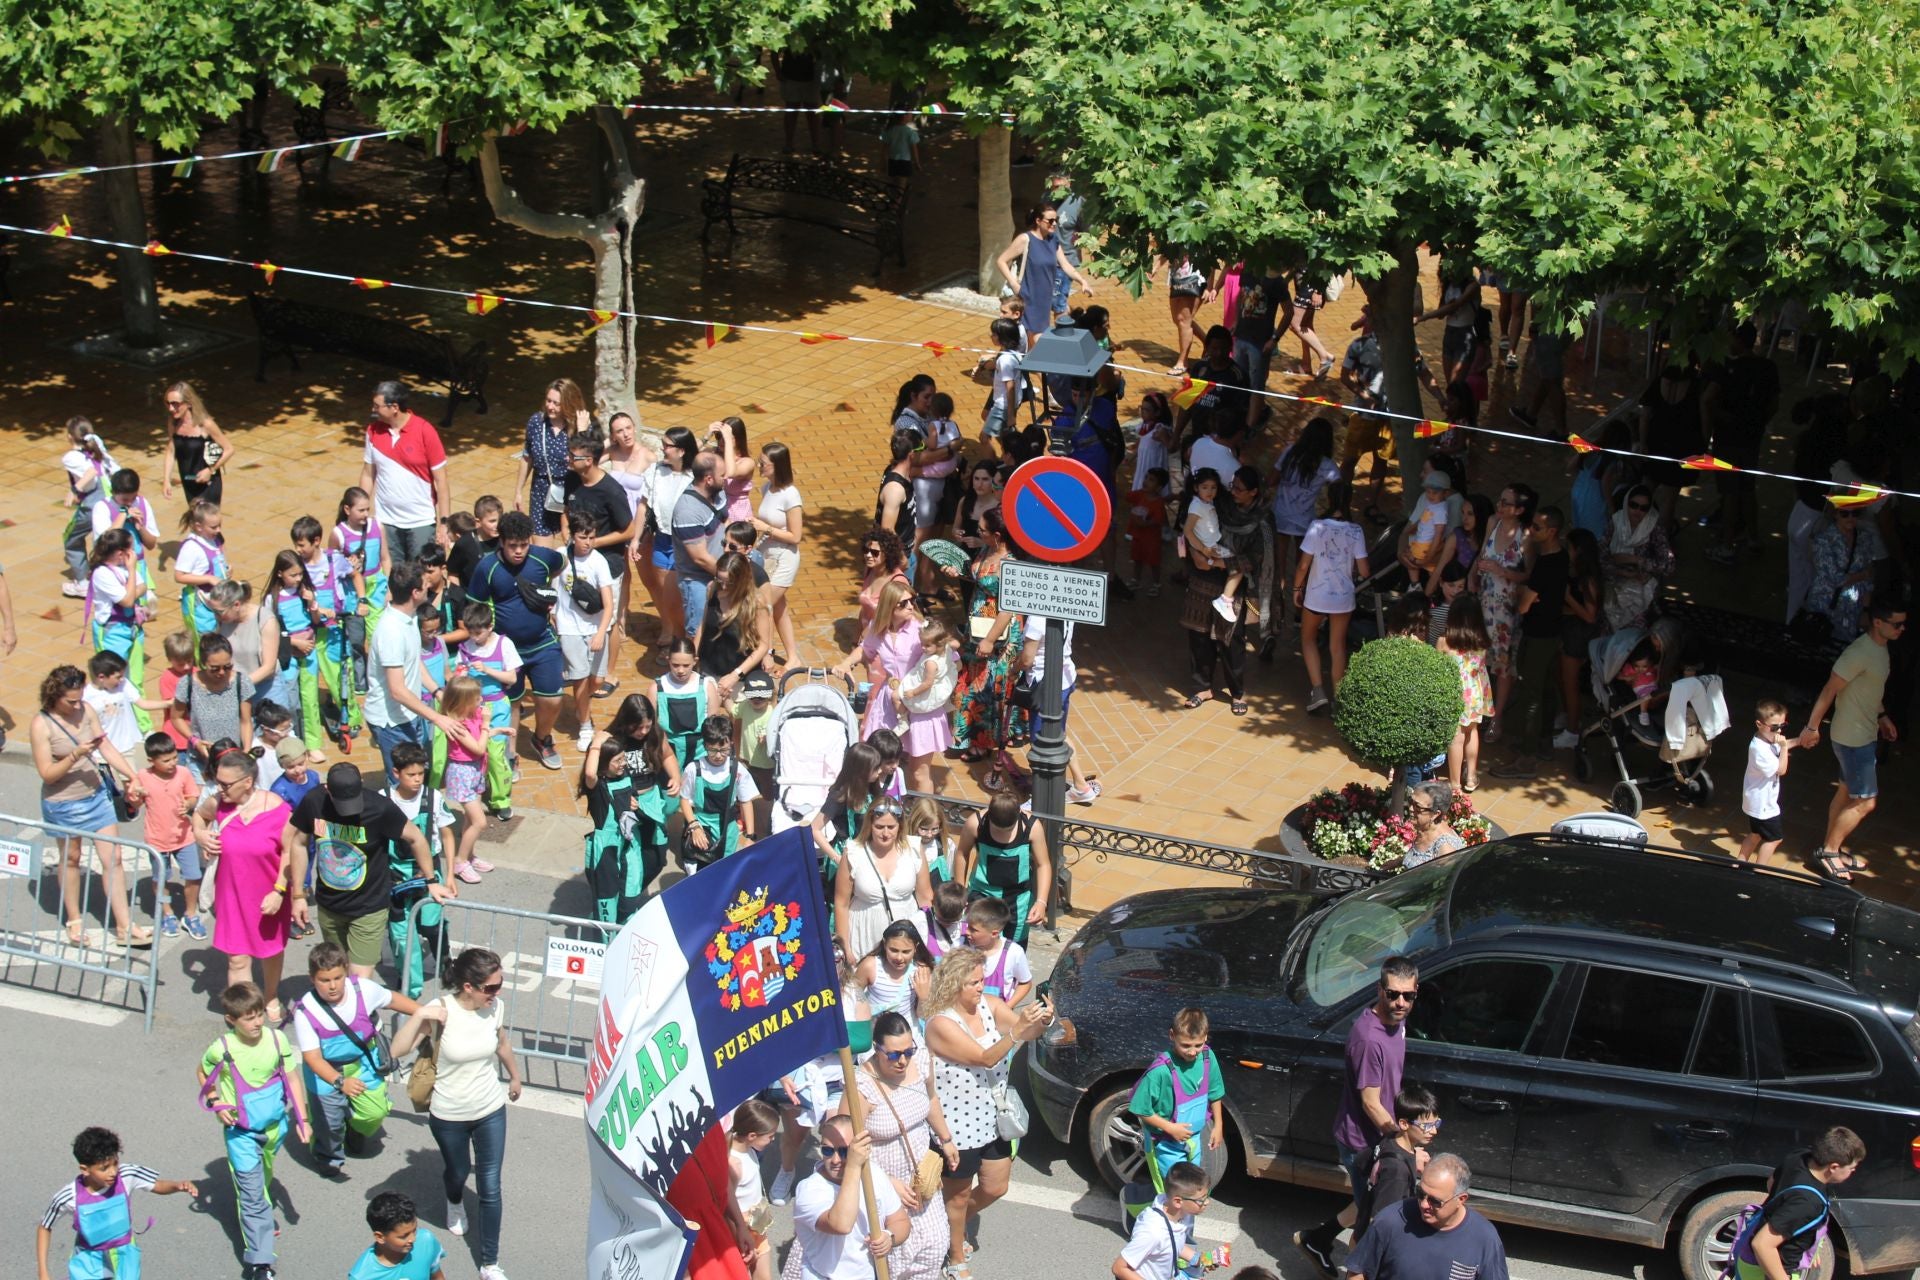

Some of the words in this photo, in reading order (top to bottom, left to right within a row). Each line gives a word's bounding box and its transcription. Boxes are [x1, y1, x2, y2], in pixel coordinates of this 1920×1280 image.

[1005, 568, 1017, 576] DE
[1020, 569, 1049, 581] LUNES
[1063, 575, 1101, 588] VIERNES
[1005, 578, 1017, 586] DE
[1020, 580, 1049, 591] 08:00
[1063, 586, 1088, 596] 15:00
[1004, 588, 1046, 601] EXCEPTO
[1050, 595, 1100, 608] PERSONAL
[1005, 599, 1022, 608] DEL
[1026, 602, 1098, 618] AYUNTAMIENTO
[550, 942, 604, 957] COLOMAQ
[713, 988, 836, 1070] FUENMAYOR
